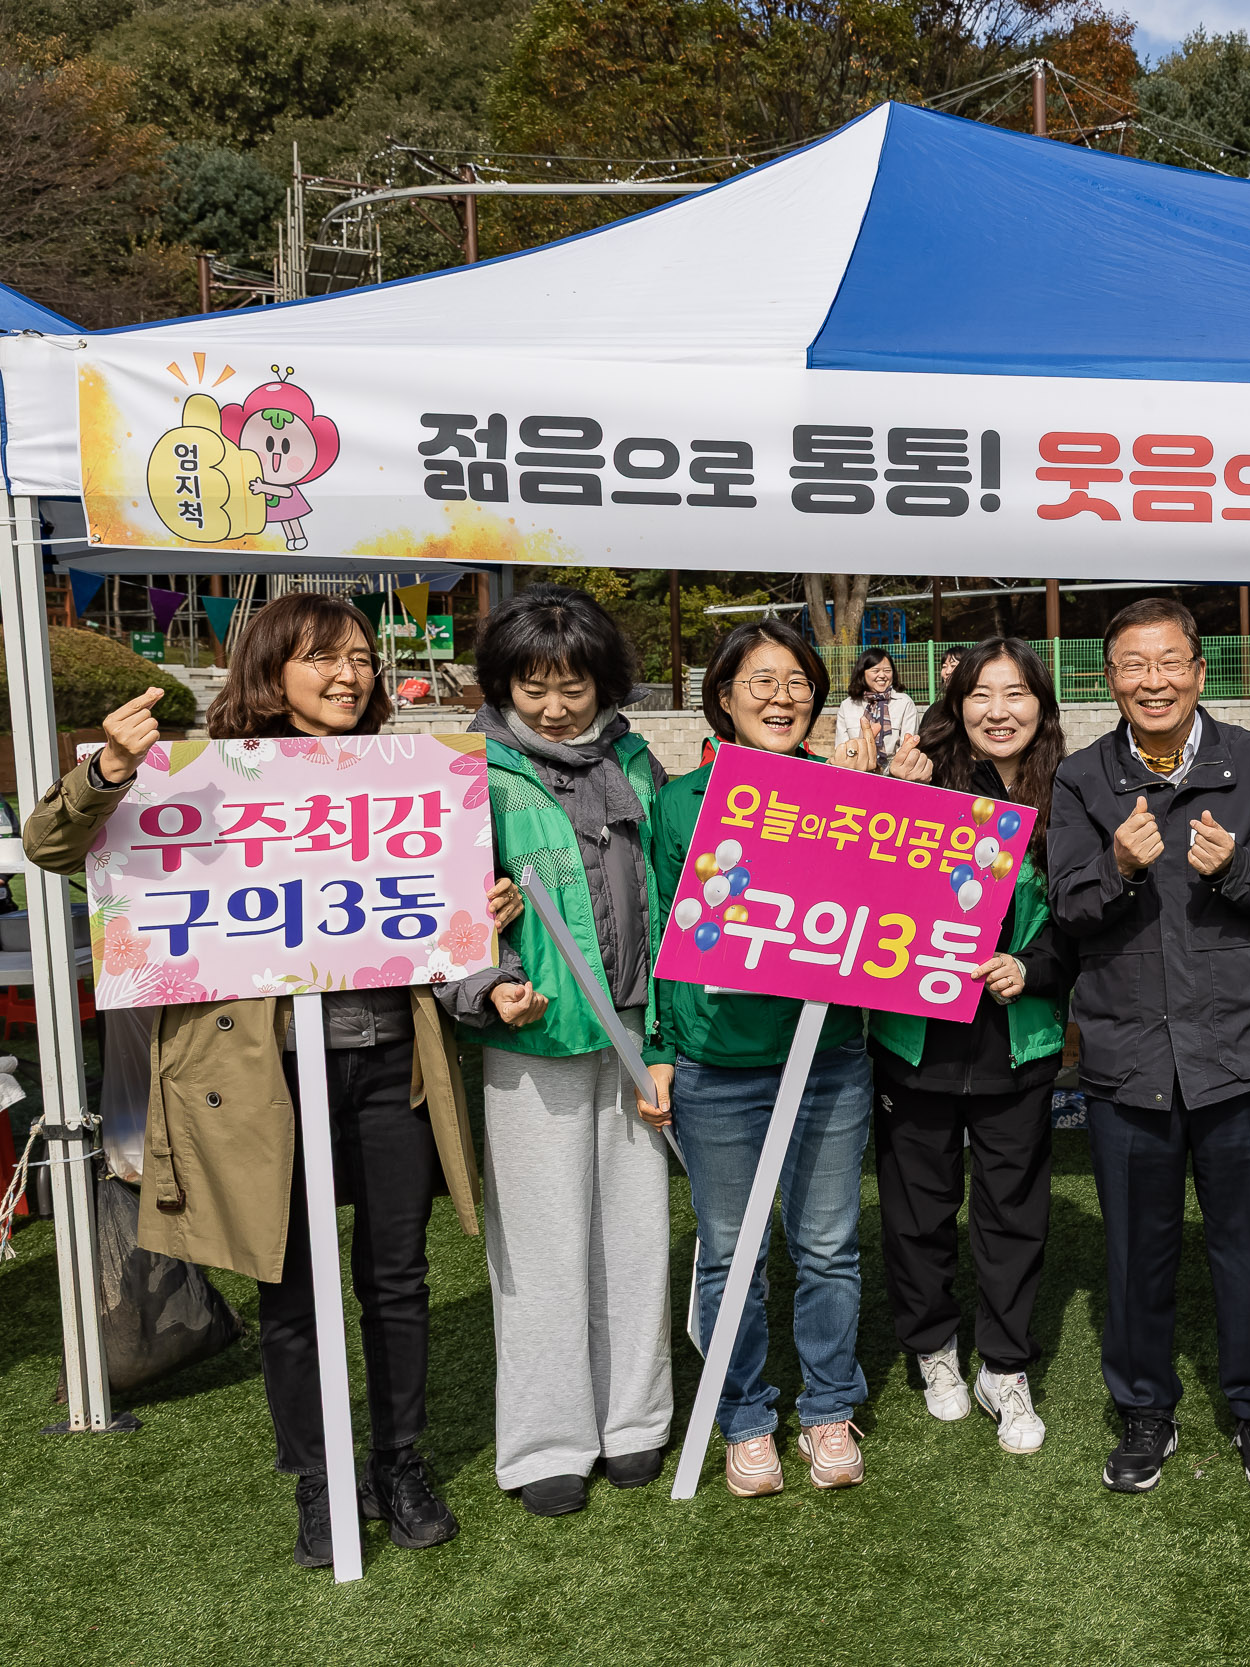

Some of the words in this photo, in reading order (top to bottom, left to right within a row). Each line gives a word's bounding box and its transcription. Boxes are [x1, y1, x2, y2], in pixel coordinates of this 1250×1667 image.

[174, 443, 204, 529] 엄지척
[417, 412, 758, 509] 젊음으로
[788, 424, 1001, 518] 통통!
[130, 789, 451, 872] 우주최강
[723, 888, 982, 1004] 구의3동
